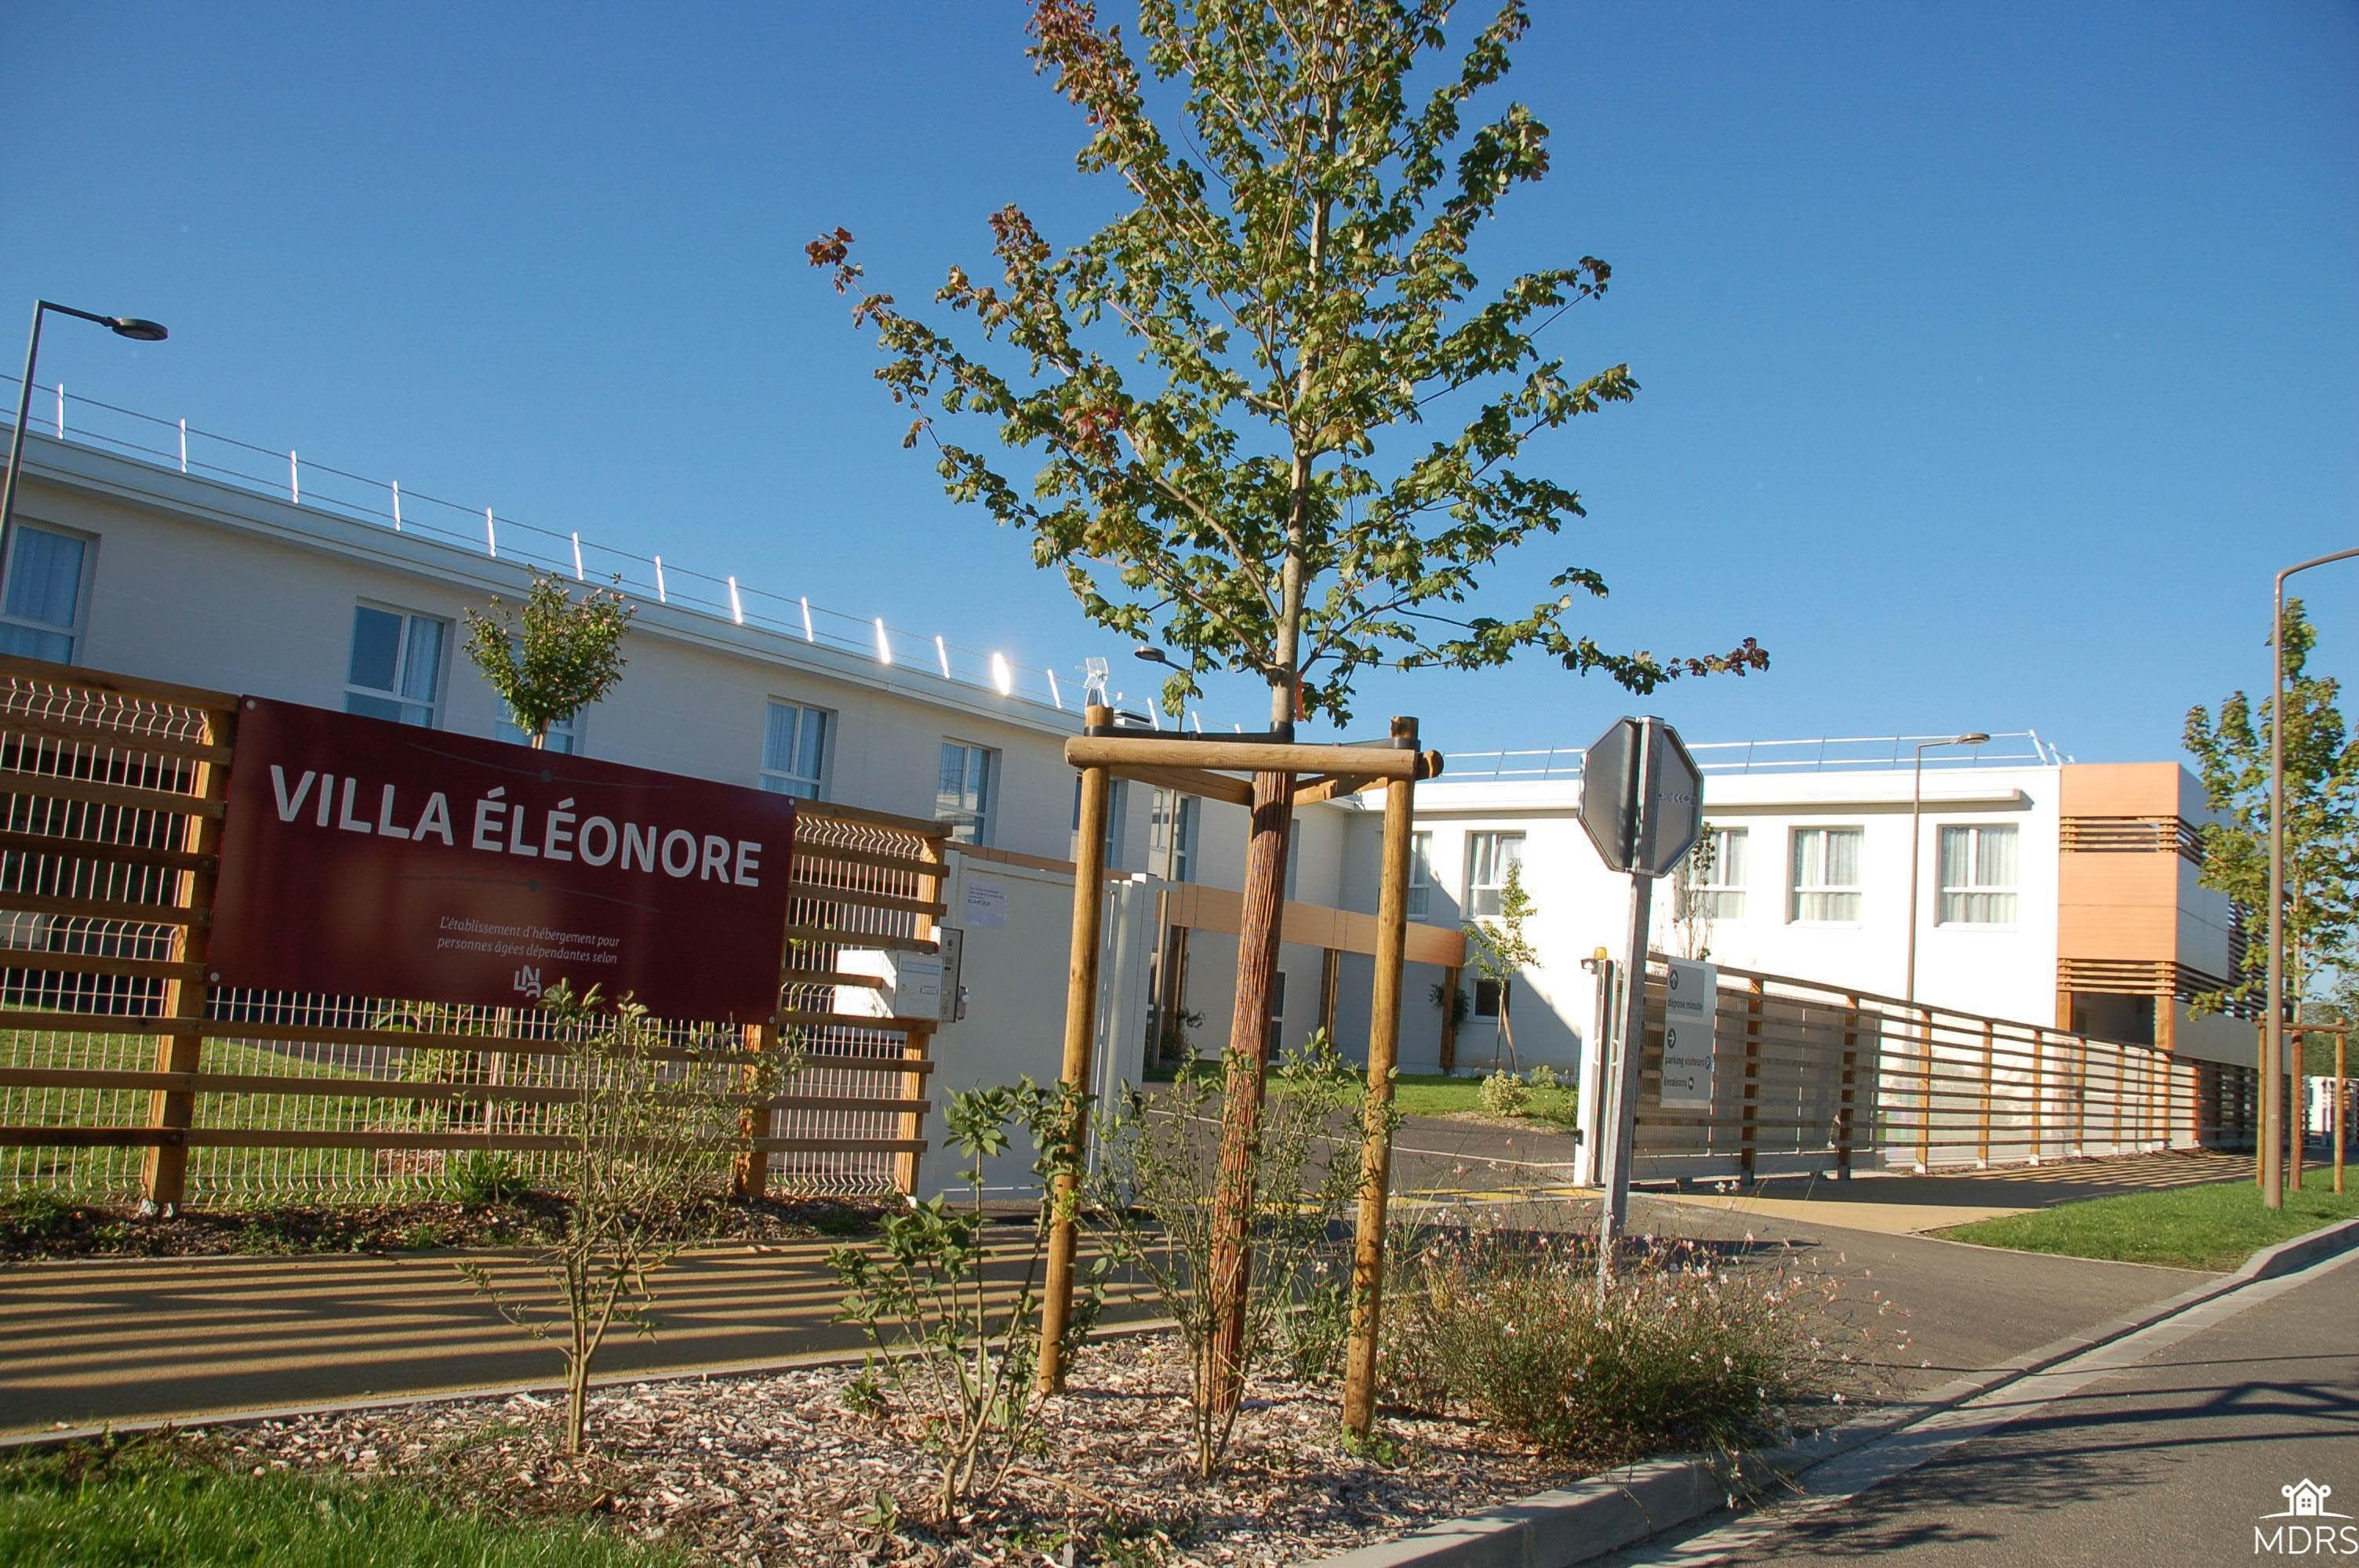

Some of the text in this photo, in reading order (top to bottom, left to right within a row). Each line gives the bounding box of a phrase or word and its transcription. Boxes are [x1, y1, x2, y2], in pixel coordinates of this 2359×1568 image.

[271, 765, 762, 887] VILLA ÉLÉONORE
[440, 916, 620, 948] L'établissement d'hébergement pour
[438, 938, 617, 964] personnes âgées dépendantes selon
[1665, 1055, 1684, 1067] parking
